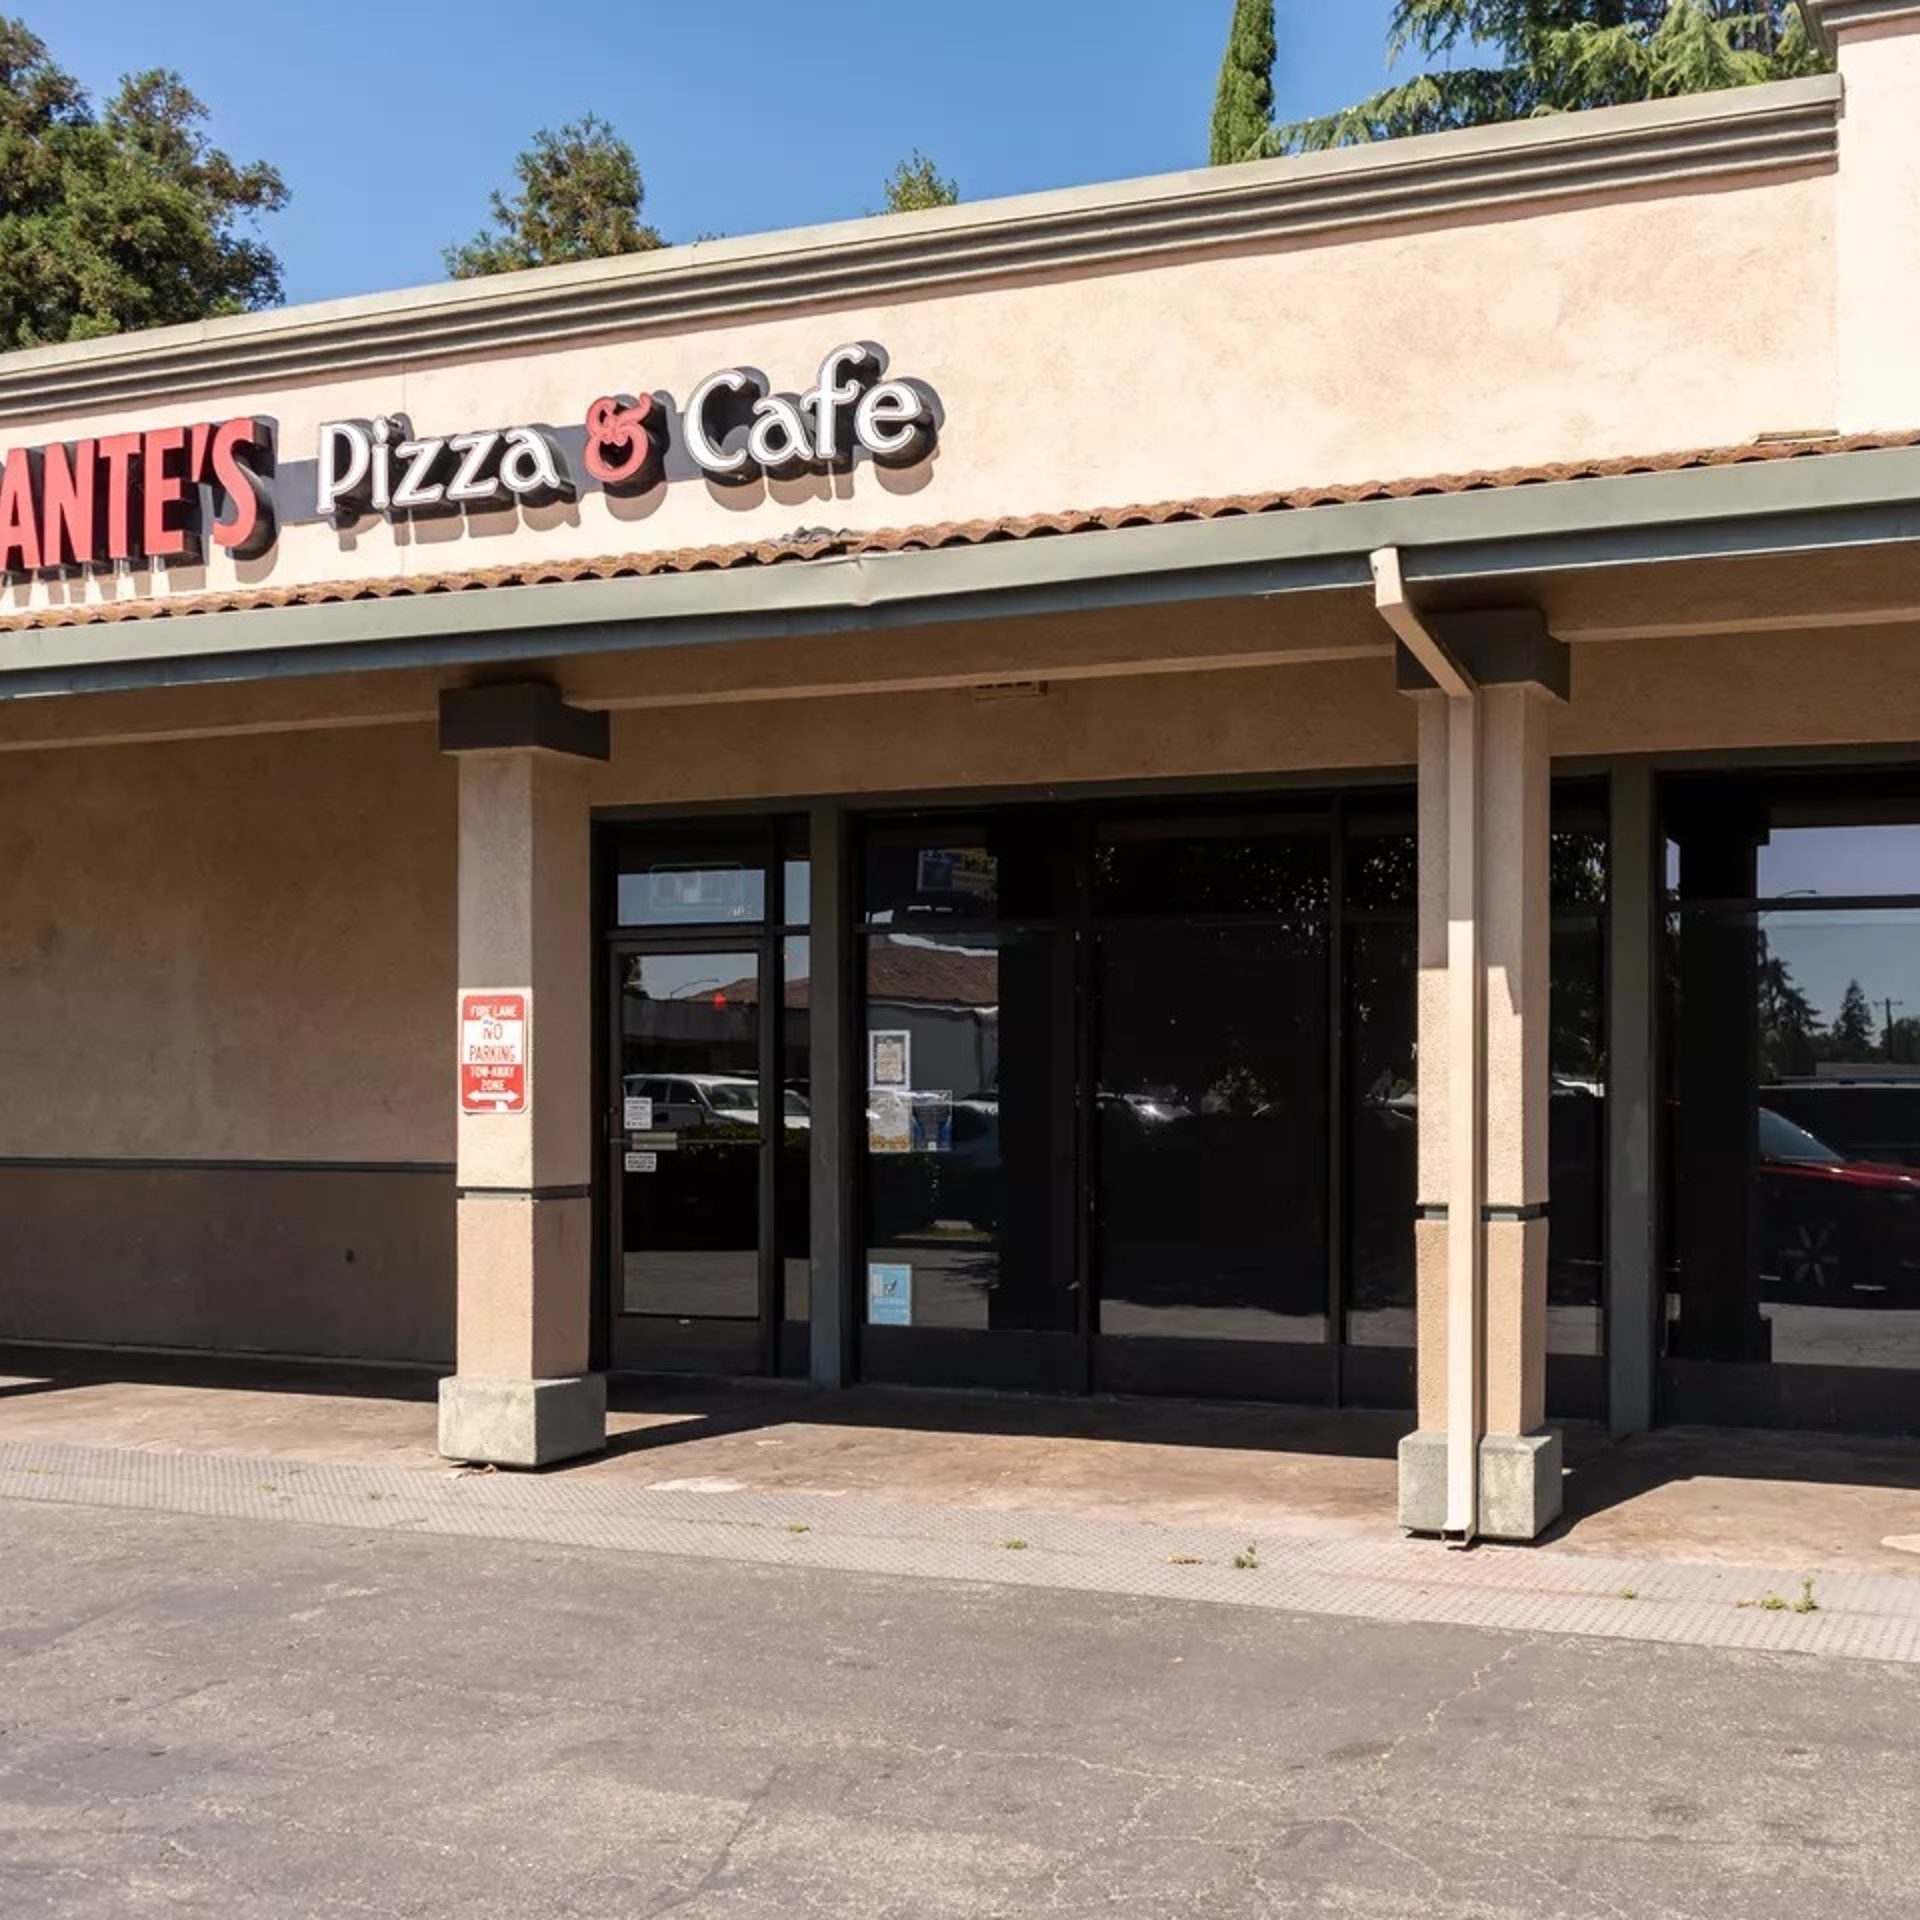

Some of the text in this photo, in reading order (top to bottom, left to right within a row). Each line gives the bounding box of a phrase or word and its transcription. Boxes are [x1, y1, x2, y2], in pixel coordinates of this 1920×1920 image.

[0, 342, 921, 570] ANTE'S Pizza & Cafe
[494, 1005, 517, 1017] LANE
[482, 1023, 503, 1040] NO
[469, 1045, 516, 1062] PARKING
[481, 1080, 505, 1091] ZONE
